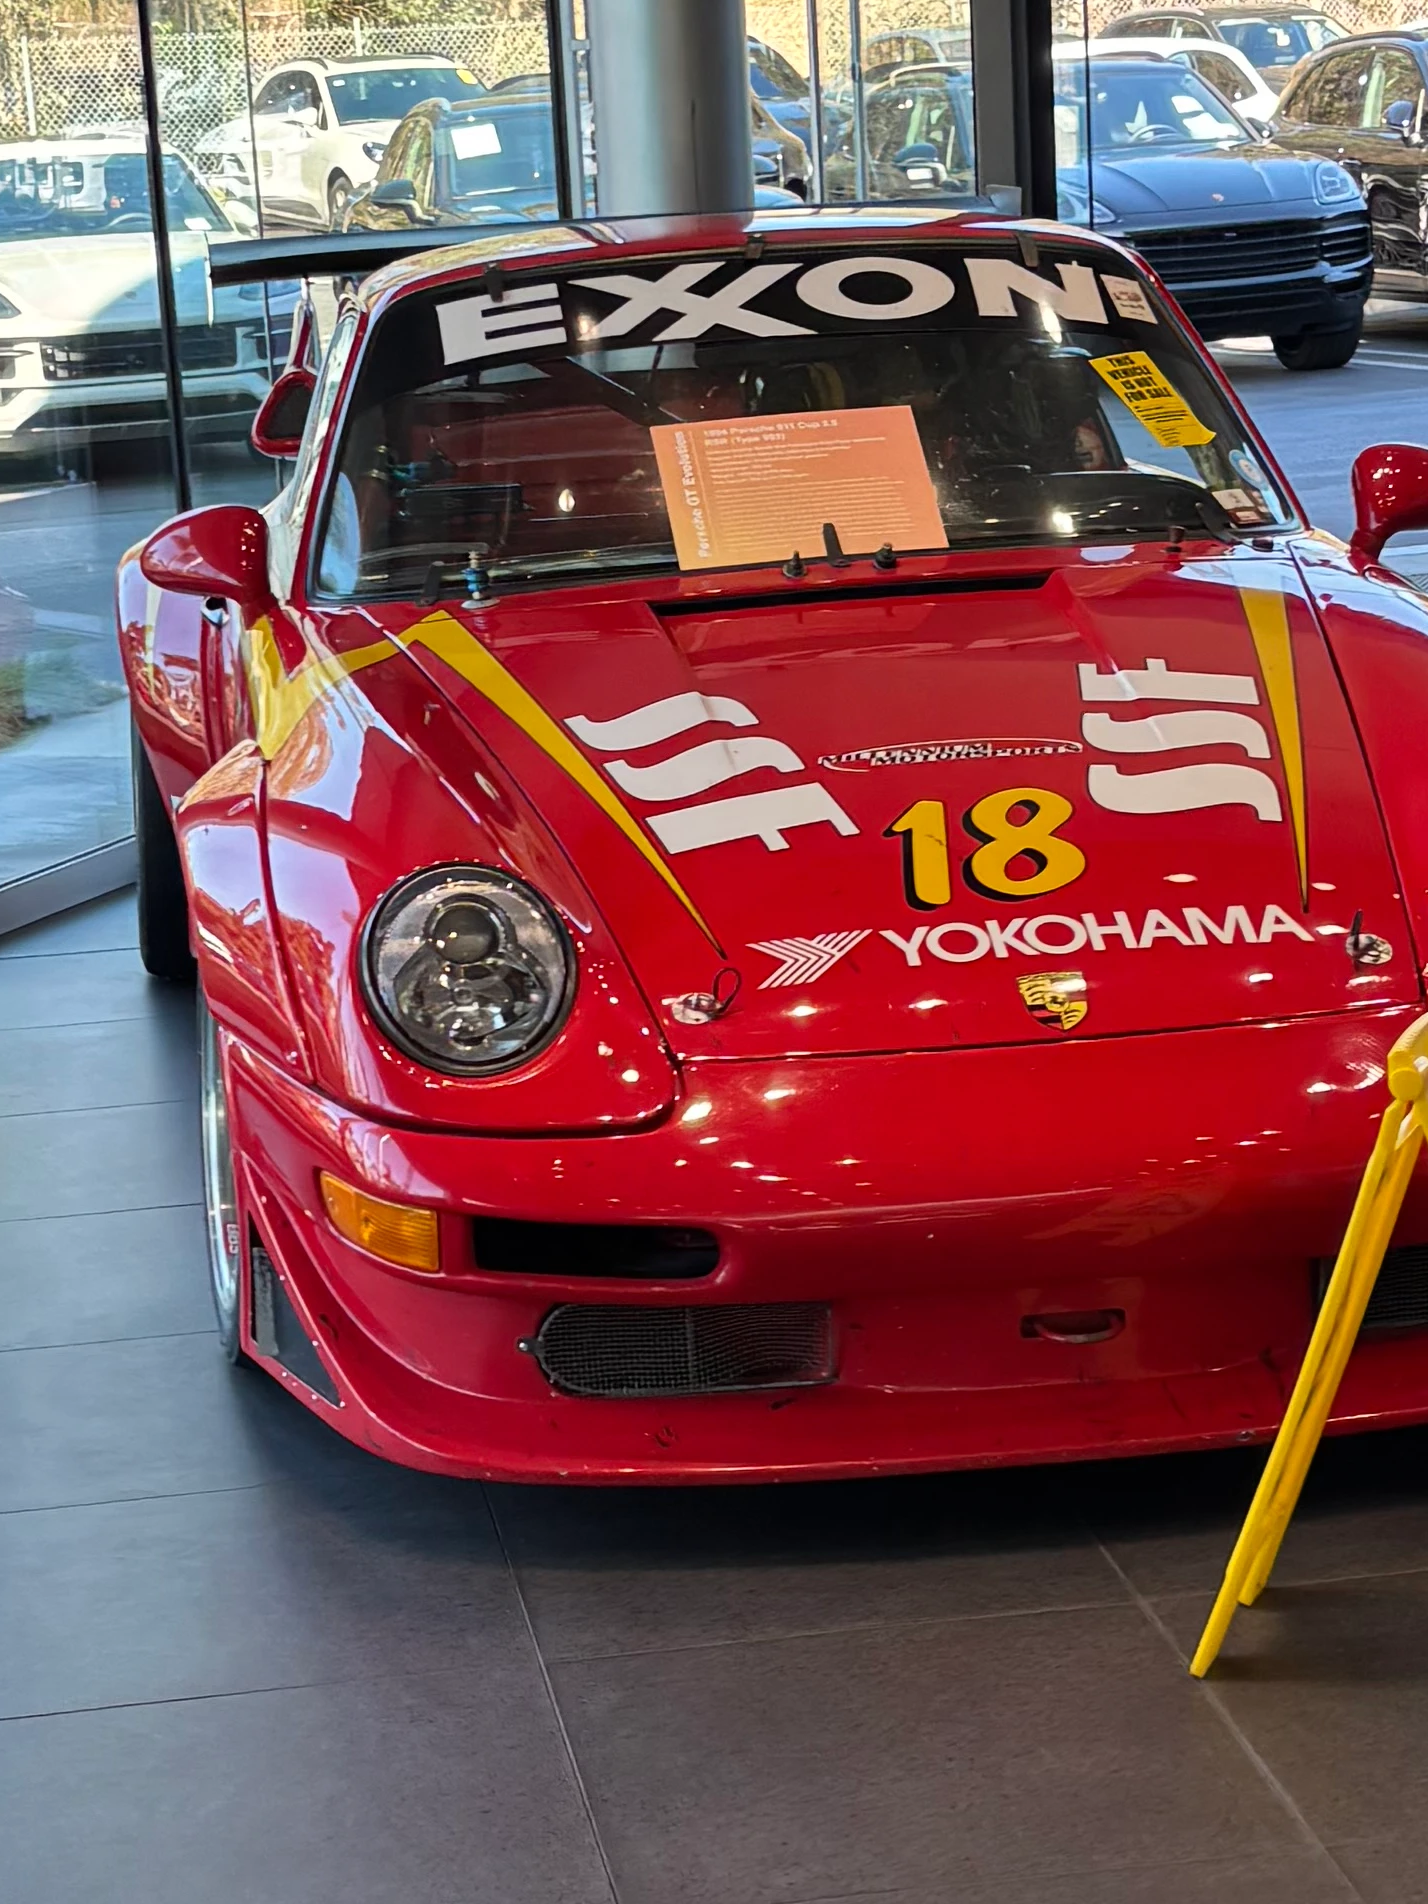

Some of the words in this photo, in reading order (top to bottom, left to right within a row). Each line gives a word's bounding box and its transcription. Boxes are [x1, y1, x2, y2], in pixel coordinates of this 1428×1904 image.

[435, 256, 1108, 365] EXXON
[1107, 355, 1136, 367] THIS
[1107, 365, 1151, 380] VEHICLE
[1120, 379, 1138, 390] IS
[1138, 376, 1157, 390] NOT
[1124, 391, 1146, 403] FOR
[1146, 386, 1173, 401] SALE
[730, 423, 774, 437] Porsche
[692, 508, 710, 559] Porsche
[1078, 658, 1283, 822] SSF
[563, 691, 860, 854] SSF
[881, 787, 1086, 912] 18
[879, 905, 1315, 967] YOKOHAMA
